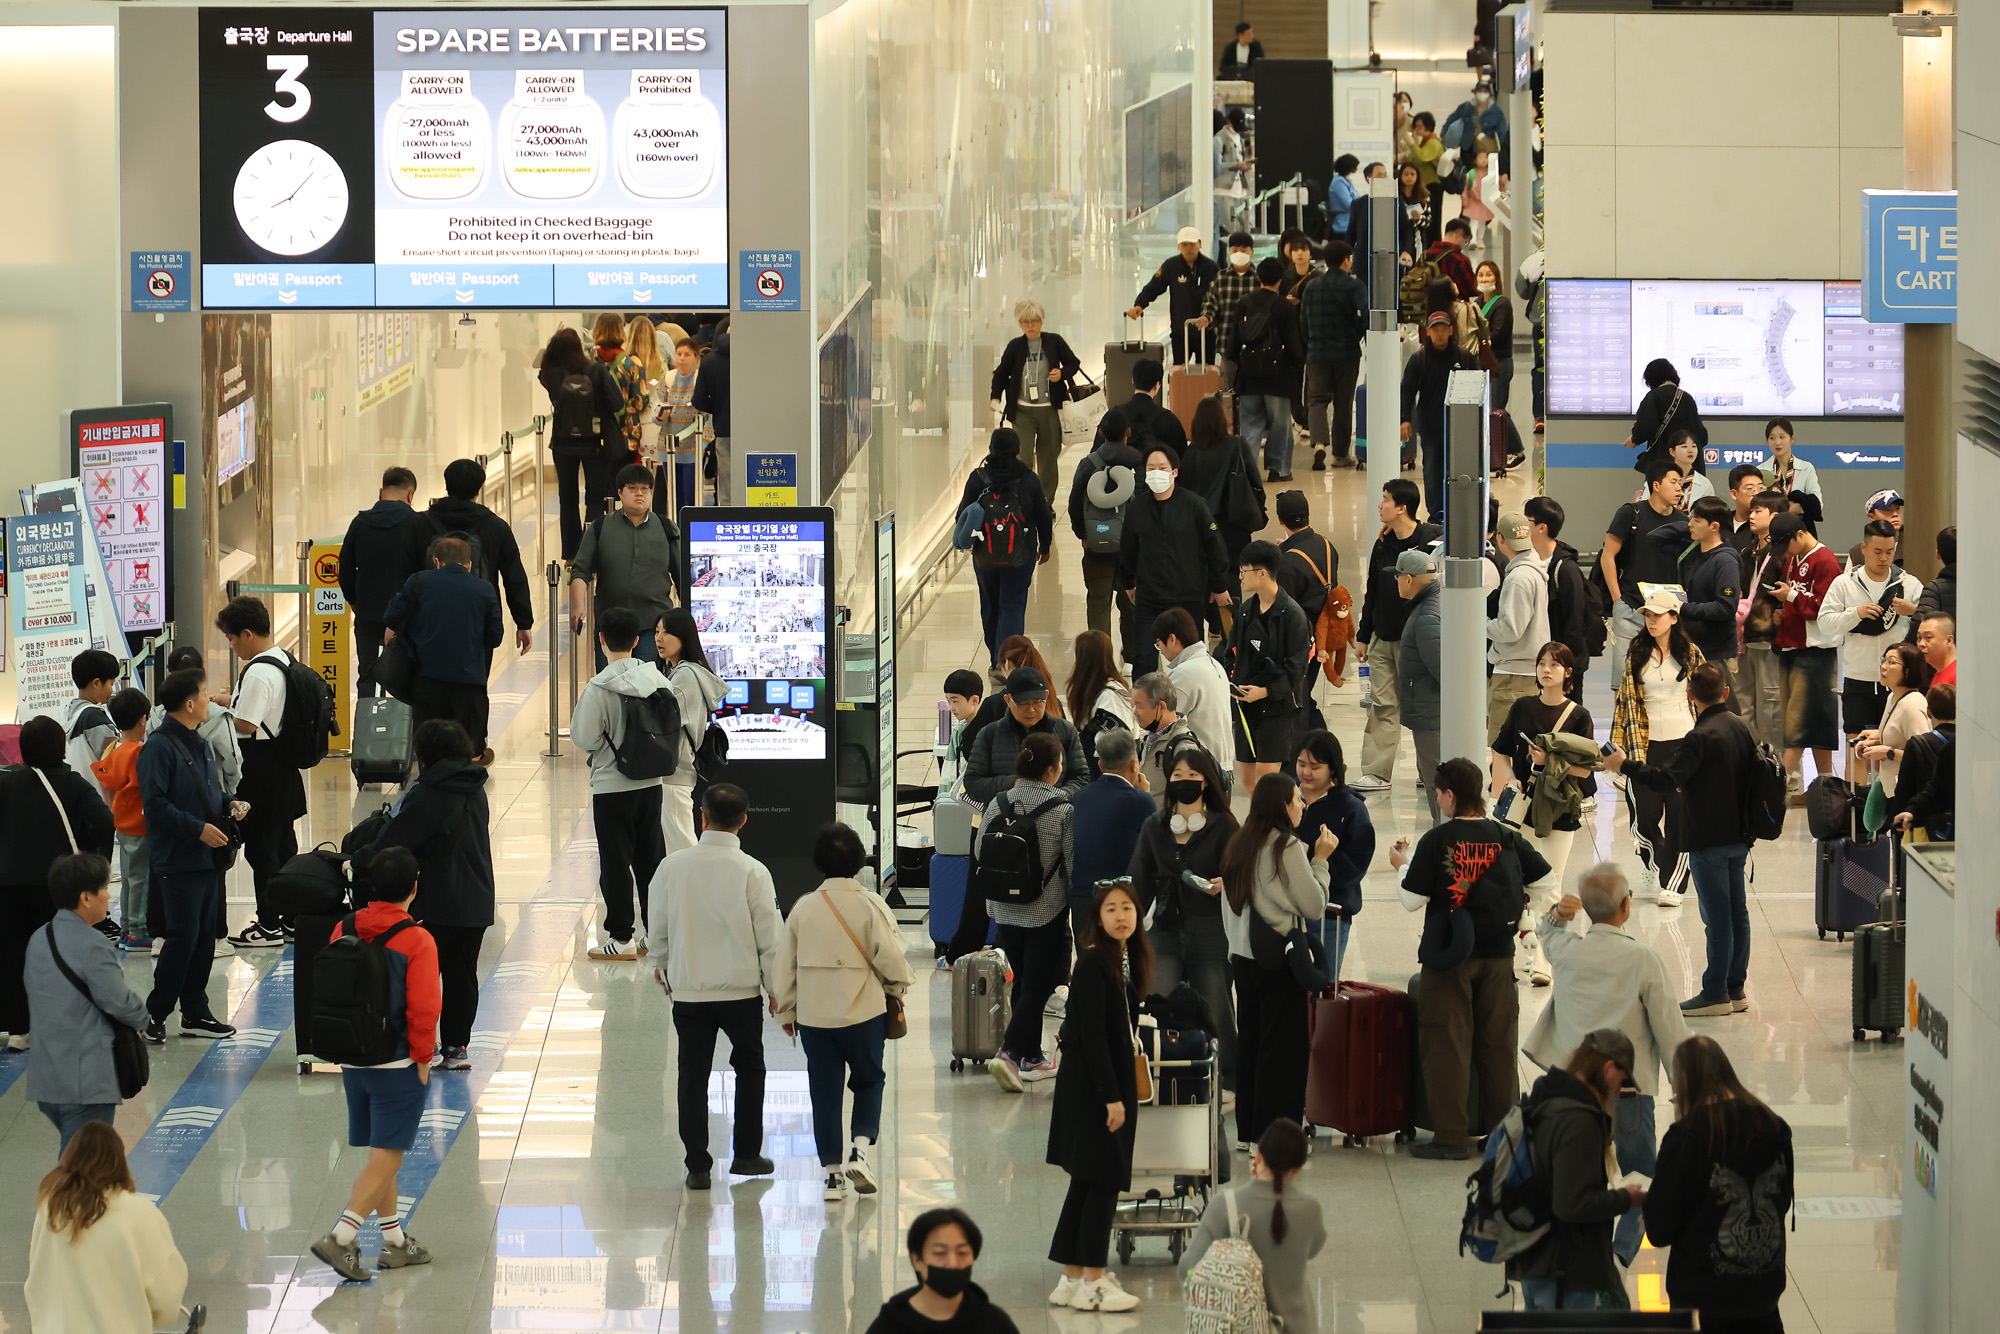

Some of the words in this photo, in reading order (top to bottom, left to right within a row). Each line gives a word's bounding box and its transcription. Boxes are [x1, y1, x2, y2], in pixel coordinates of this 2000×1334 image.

[224, 27, 269, 45] 출국장
[278, 31, 330, 45] Departure
[332, 30, 352, 42] Hall
[396, 28, 511, 53] SPARE
[518, 27, 708, 52] BATTERIES
[409, 76, 464, 84] CARRY-ON
[525, 76, 575, 84] CARRY-ON
[637, 76, 692, 84] CARRY-ON
[263, 55, 312, 123] 3
[410, 86, 463, 95] ALLOWED
[526, 86, 575, 94] ALLOWED
[639, 85, 691, 93] Prohibited
[433, 128, 455, 137] less
[521, 125, 582, 135] 27,000mAh
[633, 129, 699, 139] 43,000mAh
[451, 139, 472, 147] less)
[526, 136, 588, 146] 43,000mAh
[413, 150, 461, 159] allowed
[636, 154, 672, 162] (160Wh
[673, 154, 699, 162] over)
[449, 217, 517, 227] Prohibited
[519, 217, 532, 227] in
[534, 217, 592, 227] Checked
[594, 217, 653, 229] Baggage
[448, 231, 468, 241] Do
[470, 231, 492, 241] not
[495, 230, 529, 243] keep
[531, 230, 541, 241] it
[543, 233, 560, 241] on
[563, 230, 653, 241] overhead-bin
[1897, 226, 1957, 263] 카트
[436, 248, 494, 256] short-circuit
[496, 248, 547, 257] prevention
[549, 248, 583, 257] (Taping
[596, 248, 629, 257] storing
[631, 248, 640, 256] in
[641, 248, 672, 257] plastic
[674, 248, 700, 257] bags)
[138, 254, 183, 263] 사진촬영금지
[747, 253, 792, 262] 사진촬영금지
[233, 272, 279, 287] 일반여권
[285, 272, 342, 287] Passport
[410, 272, 456, 286] 일반여권
[462, 272, 520, 287] Passport
[587, 272, 634, 286] 일반여권
[639, 272, 697, 287] Passport
[1896, 270, 1957, 290] CART
[82, 423, 161, 442] 기내반입금지물품
[1723, 450, 1764, 463] 공항안내
[1880, 455, 1901, 463] Airport
[757, 468, 787, 477] 진입불가
[764, 491, 780, 499] 카트
[15, 521, 74, 542] 외국환신고
[715, 523, 750, 534] 출국장별
[752, 523, 778, 534] 대기열
[780, 523, 798, 534] 상황
[16, 543, 42, 556] CURRENCY
[42, 540, 75, 553] DECLARATION
[738, 544, 751, 552] 2번
[753, 544, 777, 553] 출국장
[323, 590, 338, 599] No
[738, 590, 751, 598] 4번
[753, 589, 778, 598] 출국장
[317, 602, 343, 611] Carts
[27, 618, 42, 627] over
[739, 635, 752, 643] 5번
[754, 634, 778, 643] 출국장
[26, 658, 45, 667] DECLARE
[46, 657, 52, 665] TO
[52, 655, 74, 664] CUSTOMS
[26, 666, 39, 674] OVER
[39, 665, 47, 673] USD
